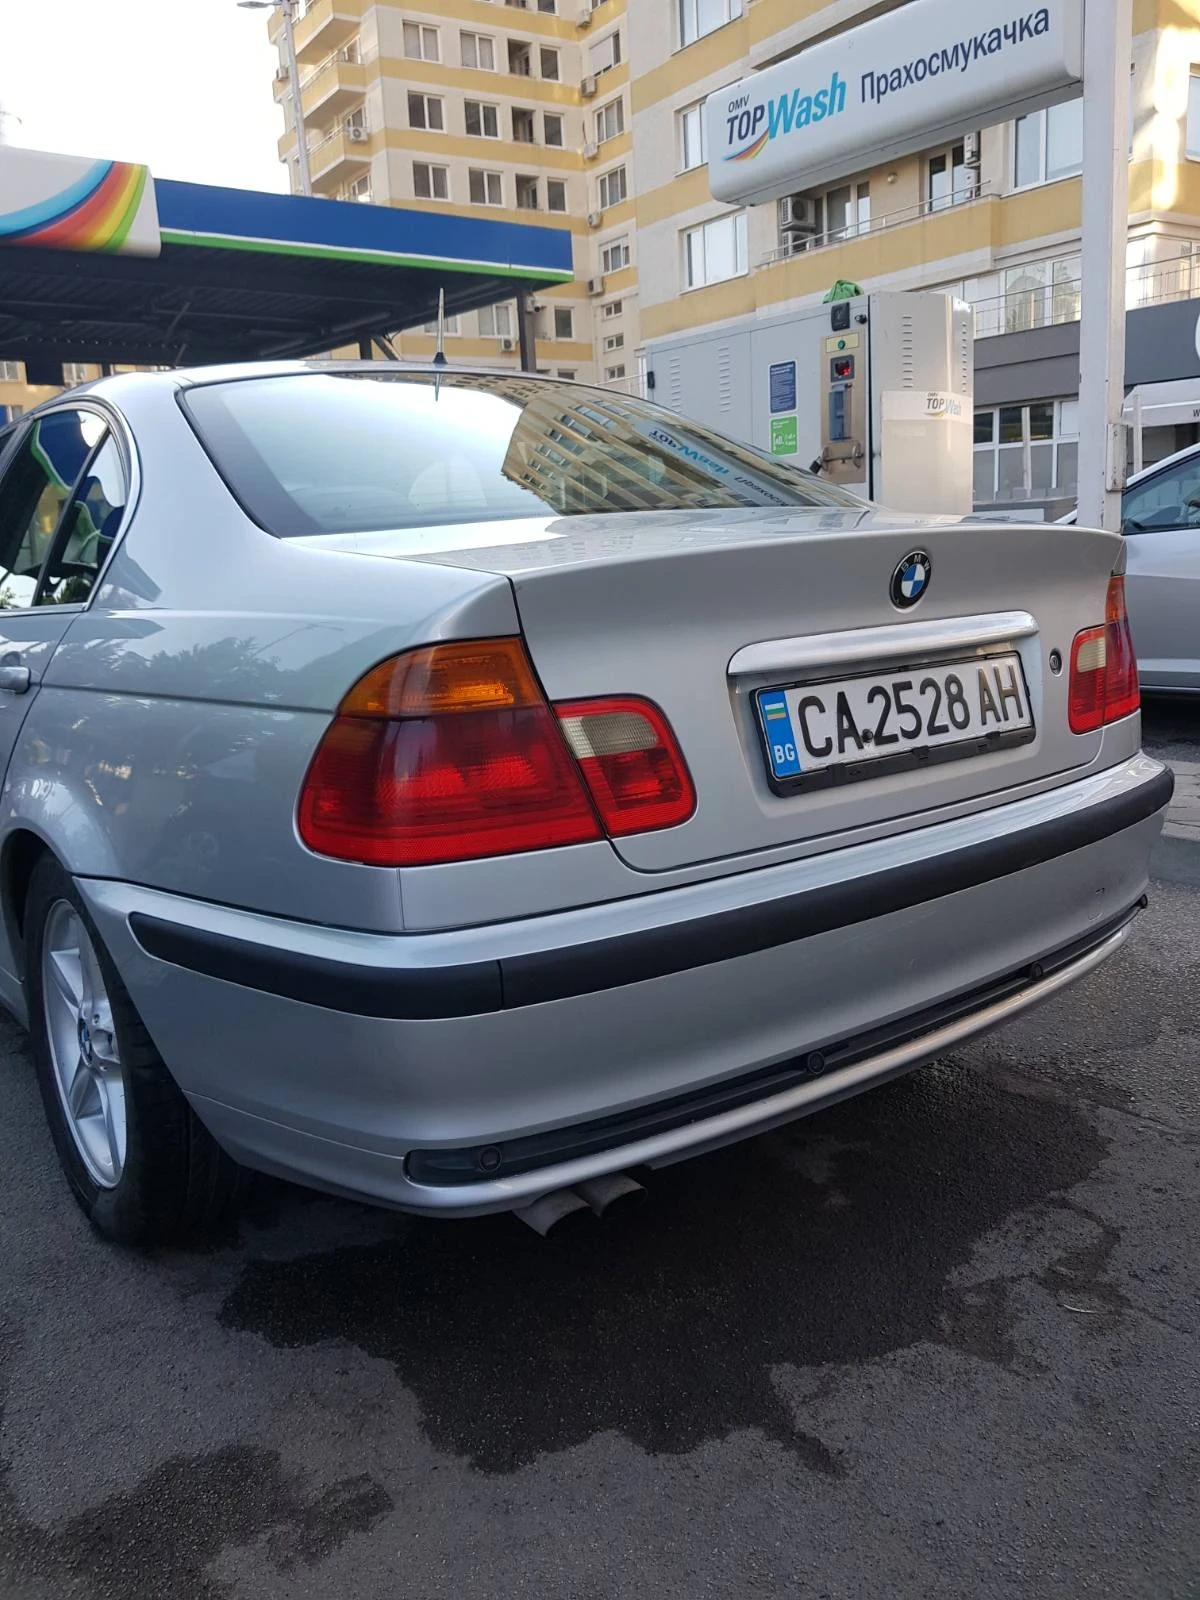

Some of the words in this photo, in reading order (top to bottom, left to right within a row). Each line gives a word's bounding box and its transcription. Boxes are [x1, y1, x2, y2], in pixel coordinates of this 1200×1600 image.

[861, 8, 1049, 103] Прахосмукачка
[728, 94, 750, 113] OMV
[900, 553, 930, 572] BMW
[798, 691, 863, 758] CA
[866, 674, 970, 746] 2528
[976, 664, 1024, 726] AH
[773, 744, 795, 764] BG
